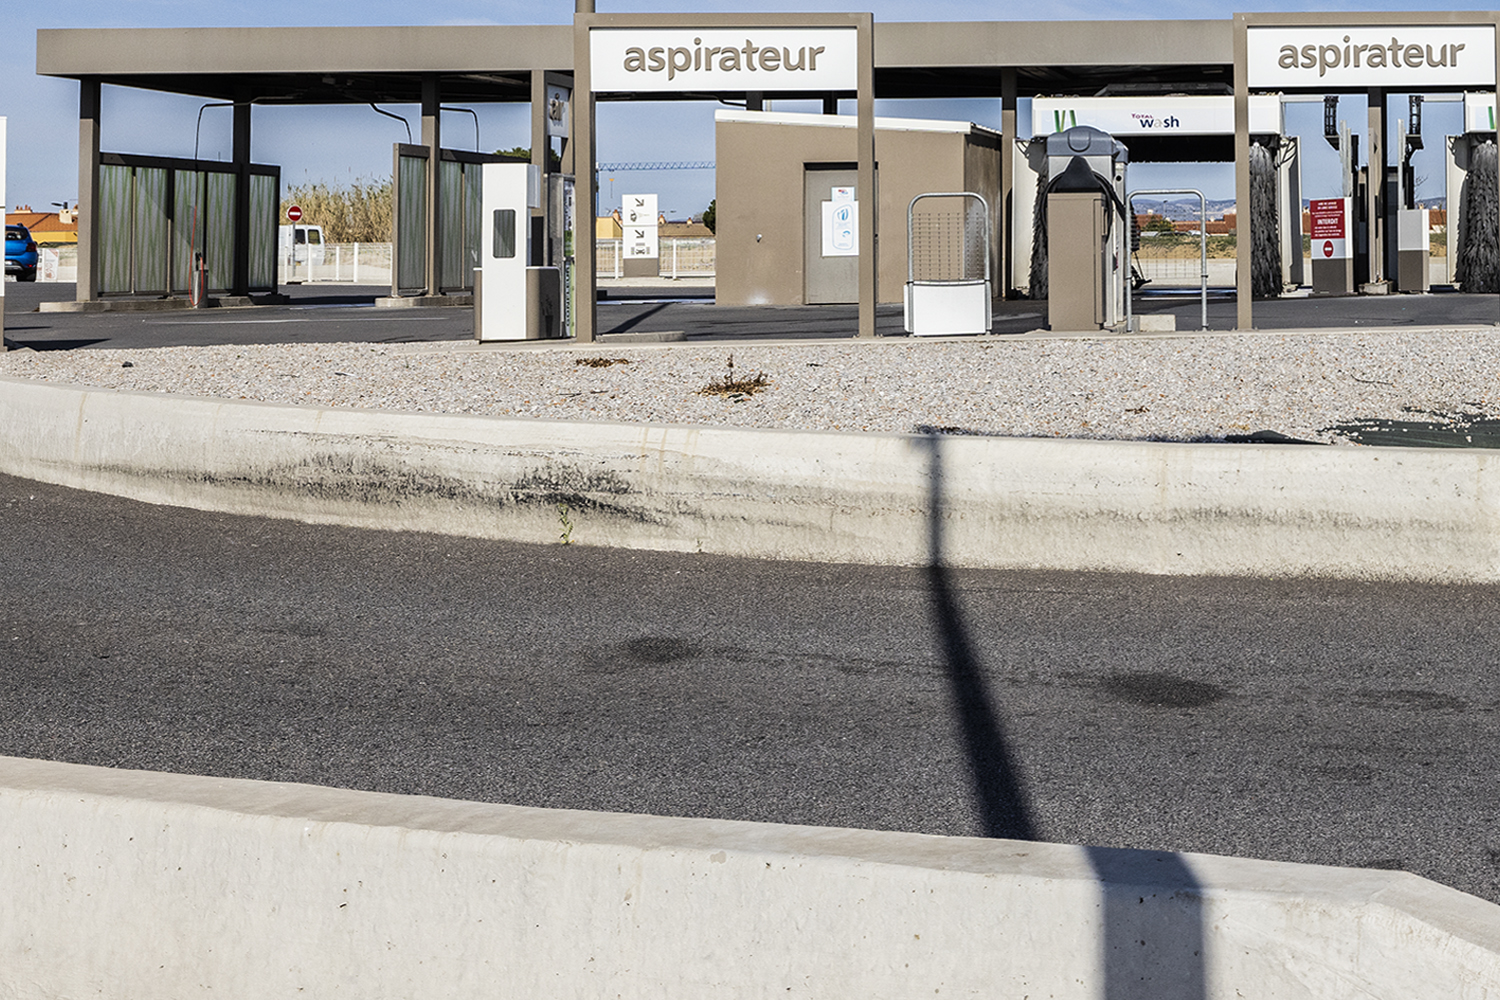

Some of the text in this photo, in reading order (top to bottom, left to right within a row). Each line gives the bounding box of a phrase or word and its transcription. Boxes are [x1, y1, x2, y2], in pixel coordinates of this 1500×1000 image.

[623, 36, 826, 81] aspirateur
[1278, 35, 1466, 78] aspirateur
[1139, 115, 1180, 128] wash
